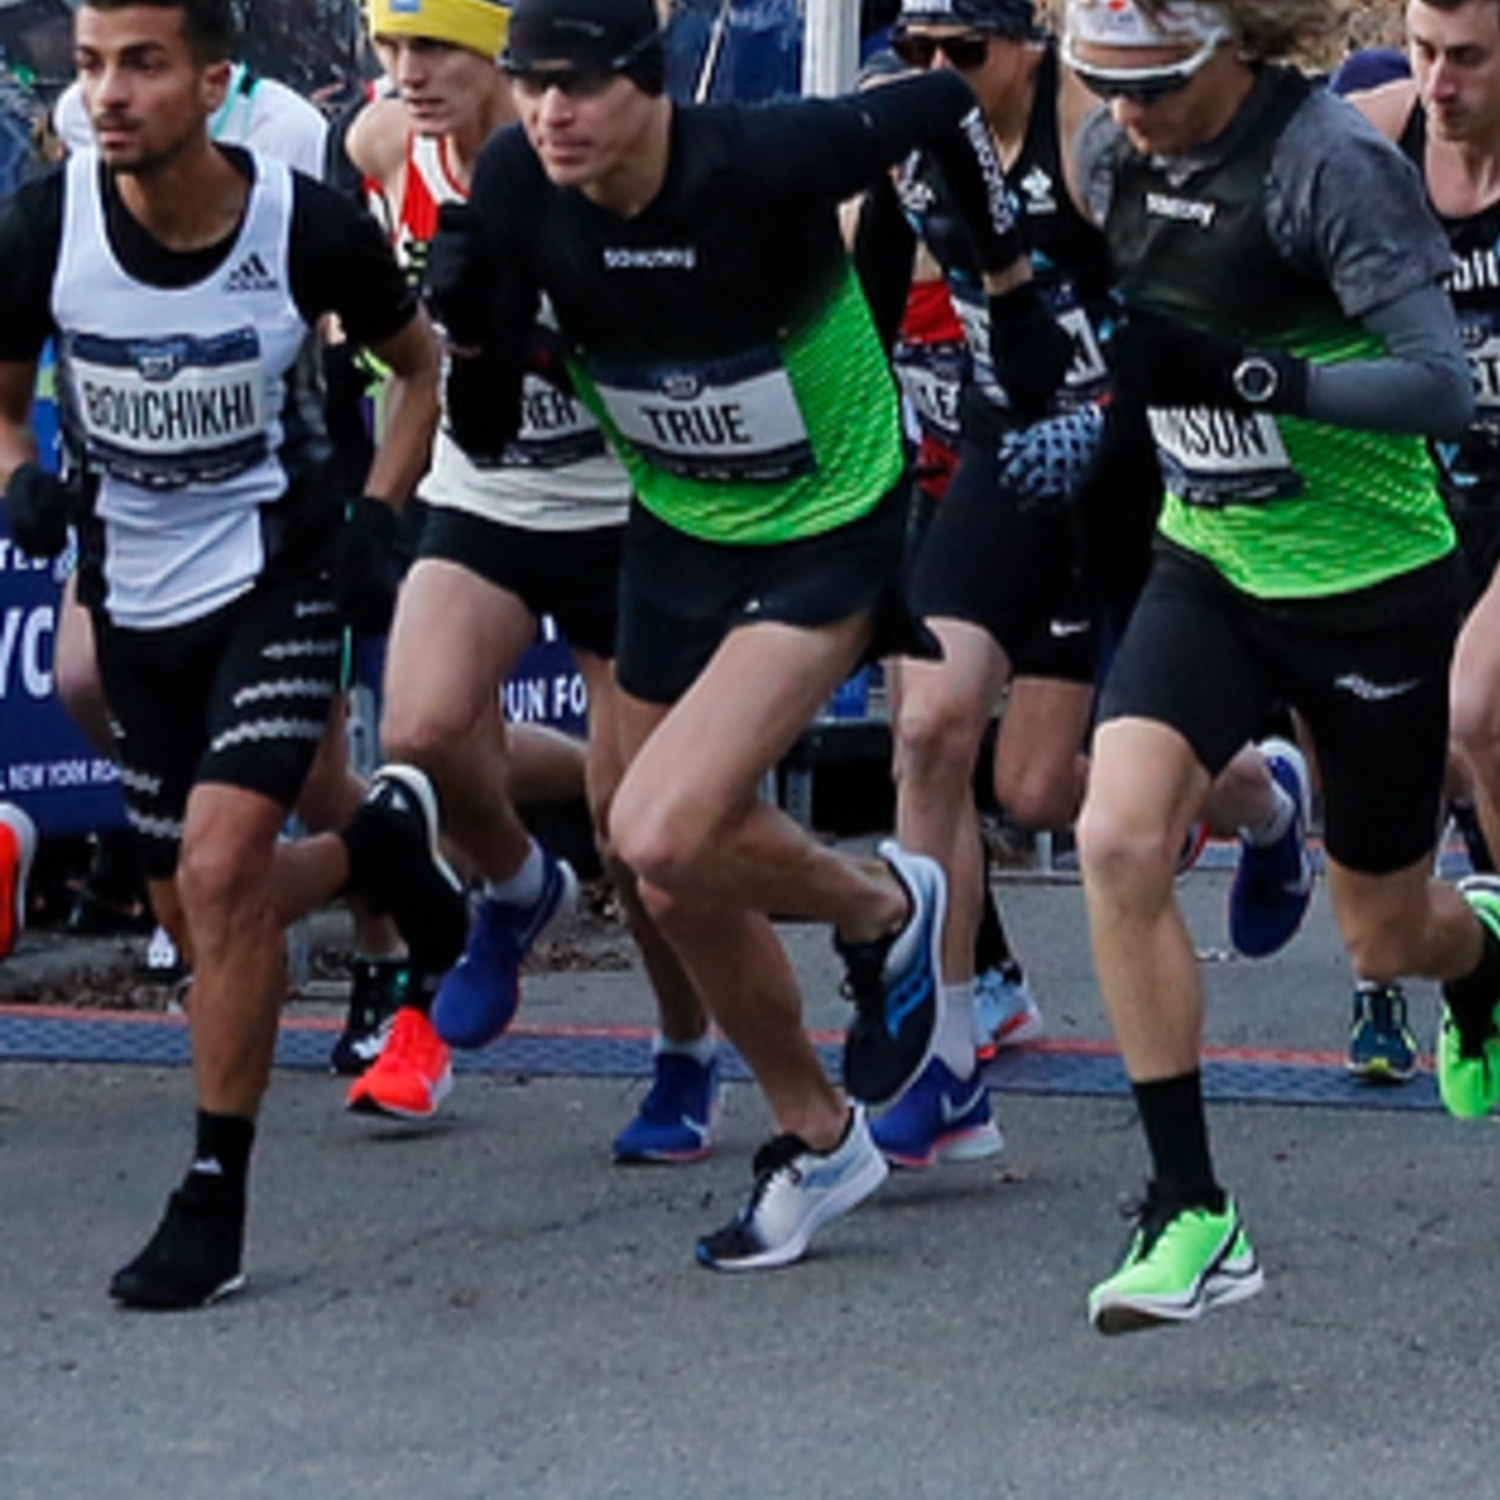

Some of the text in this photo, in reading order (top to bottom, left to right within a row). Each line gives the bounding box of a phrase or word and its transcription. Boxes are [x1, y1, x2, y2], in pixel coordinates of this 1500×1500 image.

[639, 403, 753, 445] TRUE
[499, 674, 587, 723] UN FO
